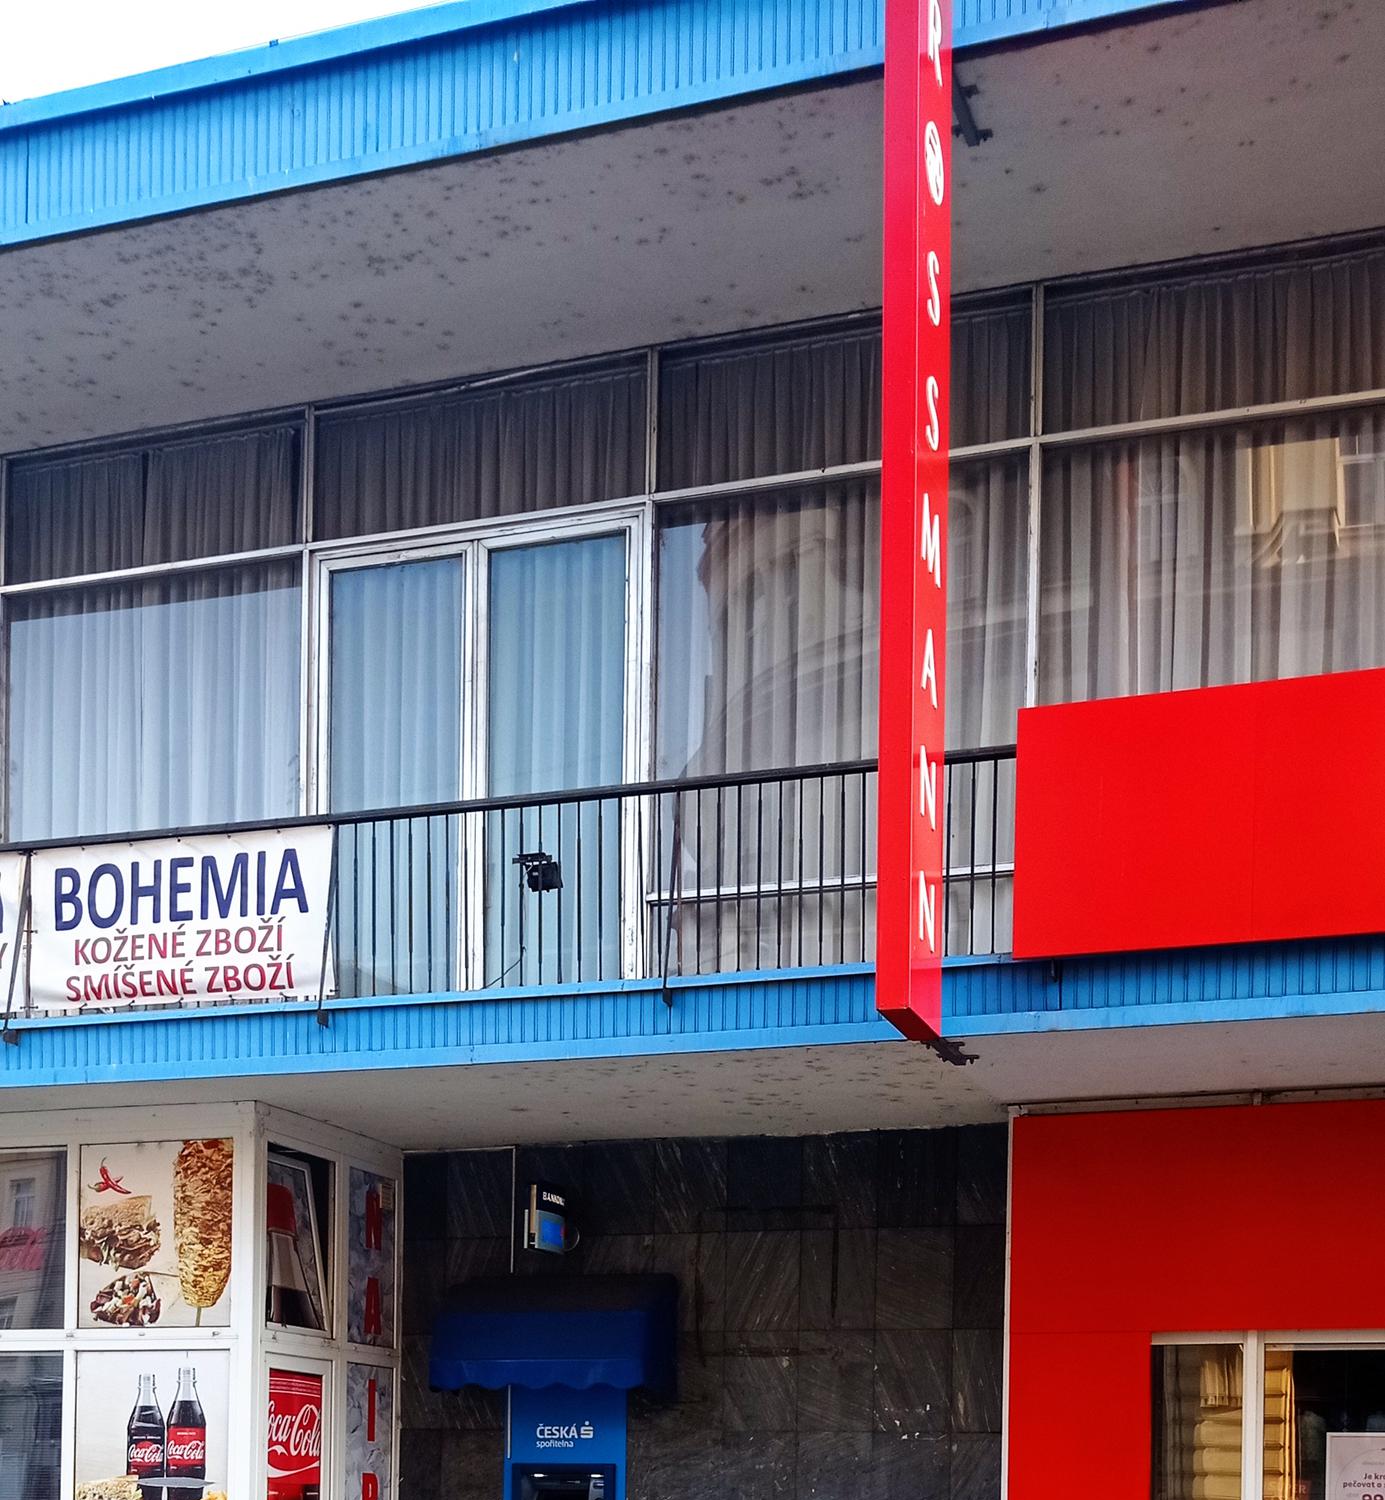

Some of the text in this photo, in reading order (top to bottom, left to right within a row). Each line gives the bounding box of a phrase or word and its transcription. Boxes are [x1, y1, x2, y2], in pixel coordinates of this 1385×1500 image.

[919, 0, 945, 953] ROSSMANN
[54, 848, 309, 931] BOHEMIA
[74, 916, 286, 966] KOŽENÉ ZBOŽÍ
[66, 953, 296, 1003] SMÍŠENÉ ZBOŽÍ
[536, 1423, 578, 1439] ČESKÁ
[536, 1440, 574, 1449] spořitelna
[1342, 1480, 1375, 1489] pečovat
